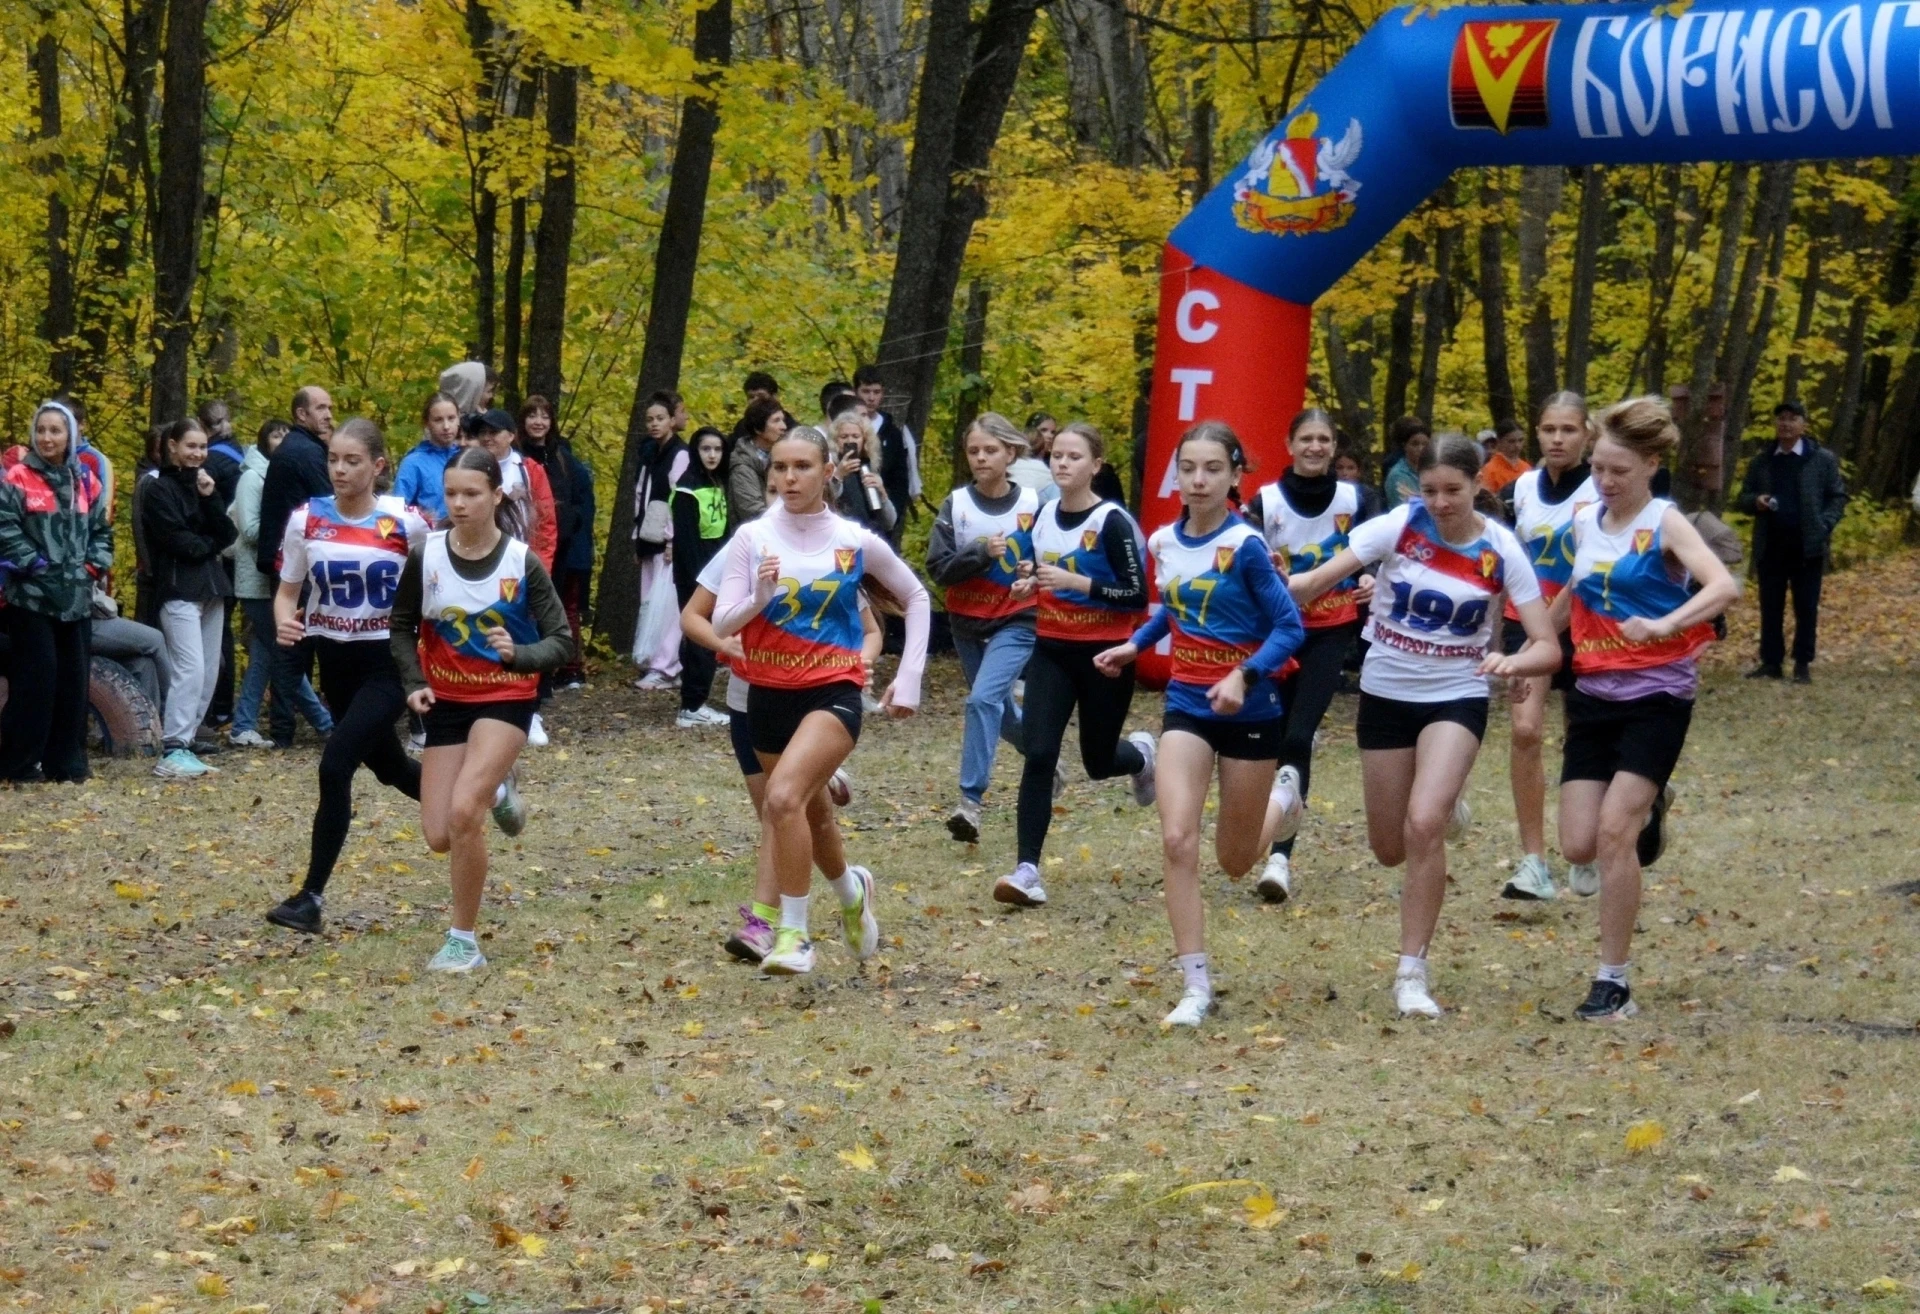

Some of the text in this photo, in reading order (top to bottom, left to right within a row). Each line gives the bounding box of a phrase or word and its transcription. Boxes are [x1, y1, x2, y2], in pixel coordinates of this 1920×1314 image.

[310, 560, 400, 609] 156
[775, 576, 841, 630] 37
[1163, 575, 1218, 626] 47
